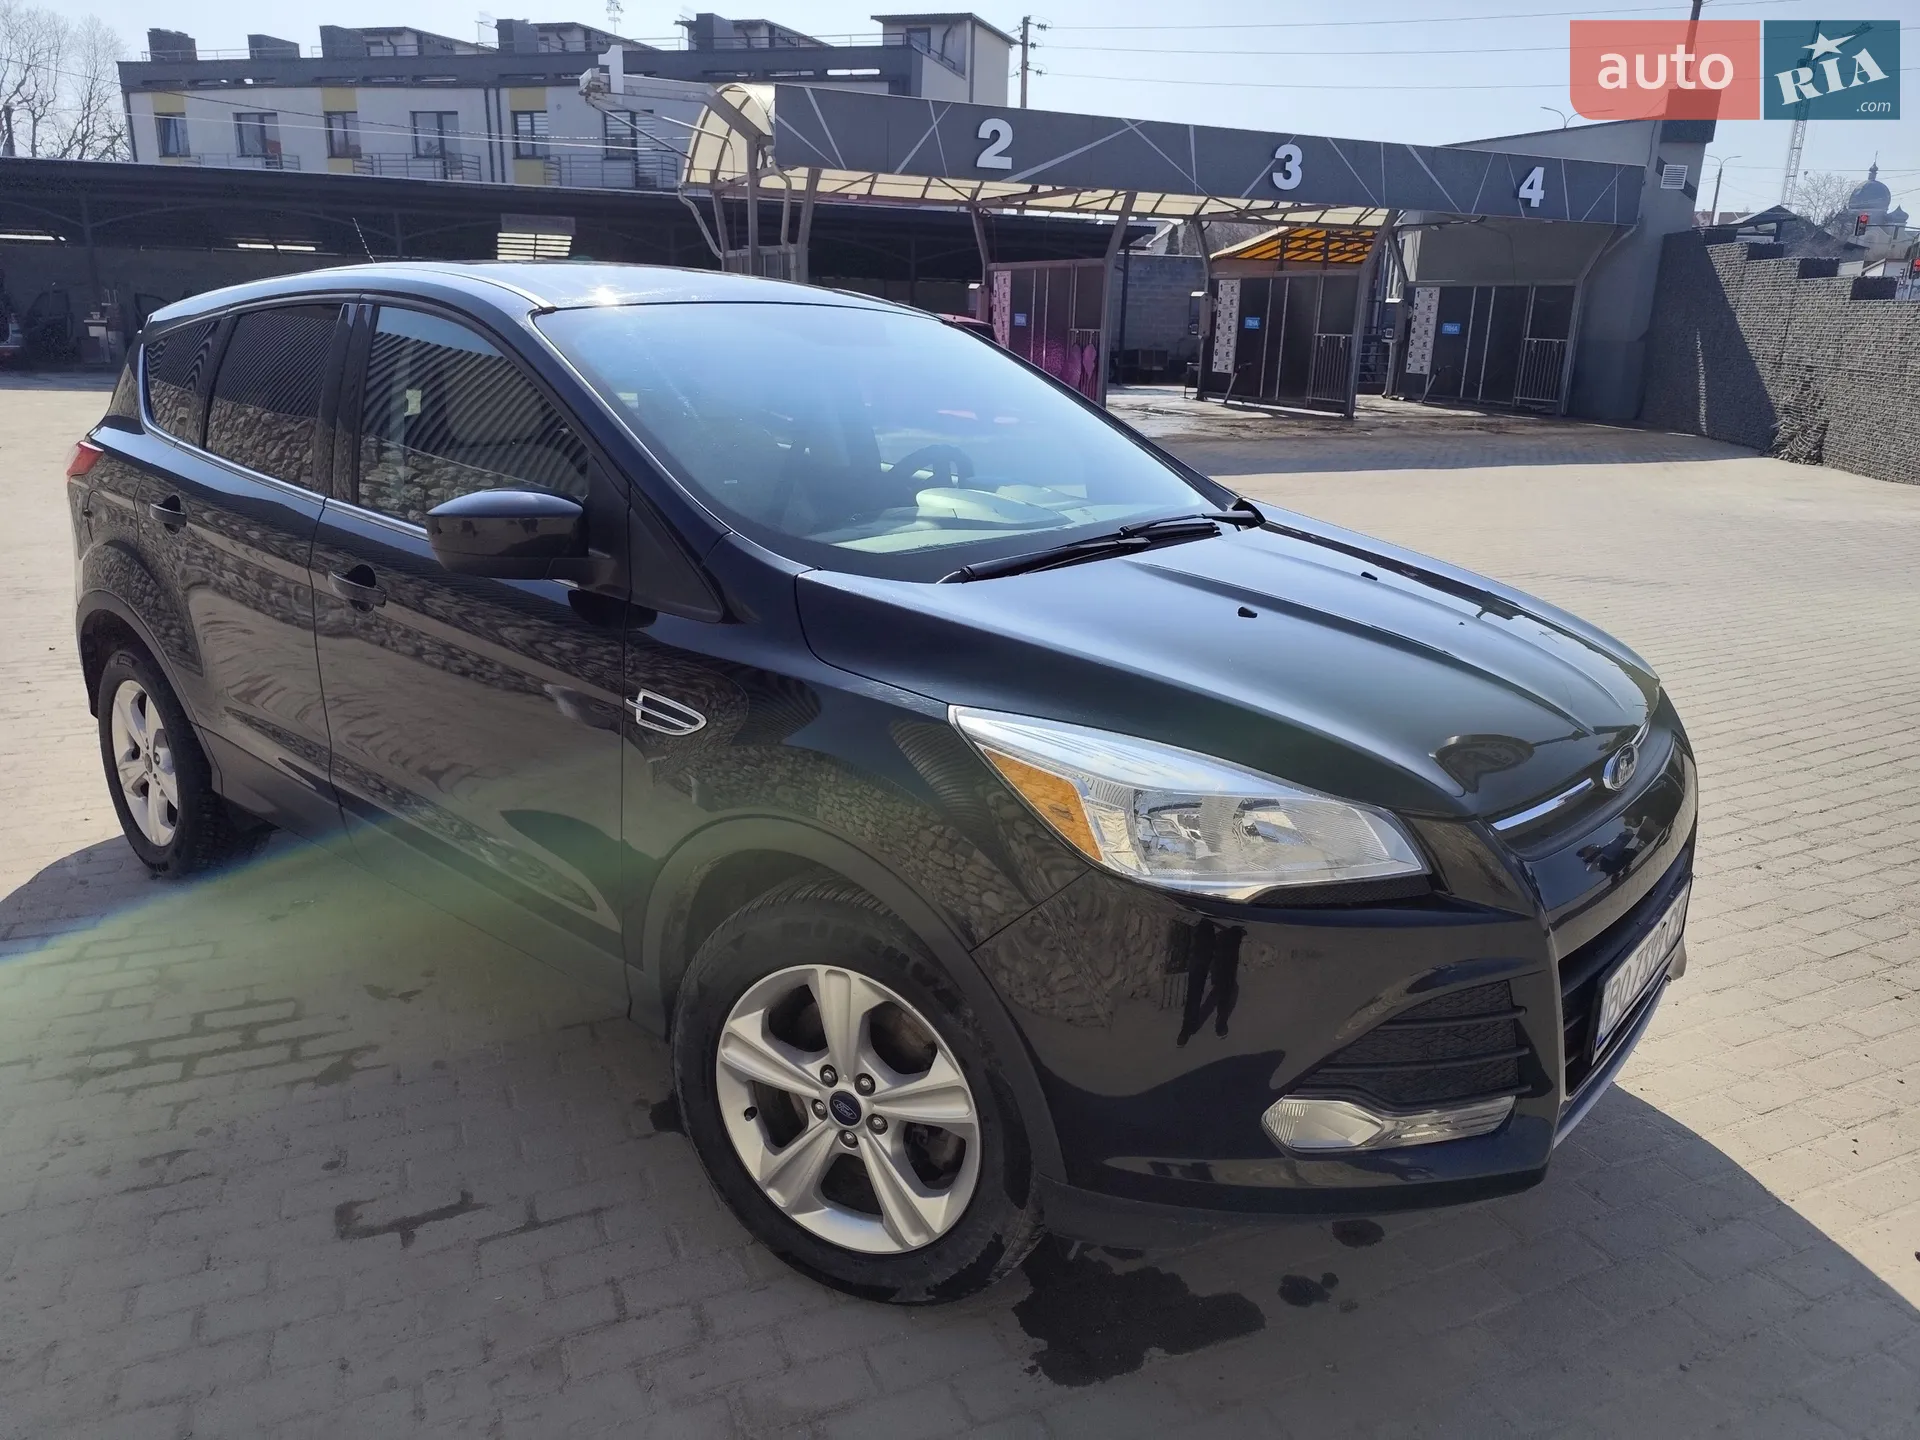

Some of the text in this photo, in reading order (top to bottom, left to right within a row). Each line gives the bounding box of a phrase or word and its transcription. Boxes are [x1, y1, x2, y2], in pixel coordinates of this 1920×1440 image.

[598, 45, 624, 94] 1
[976, 118, 1013, 169] 2
[1272, 144, 1302, 190] 3
[1519, 166, 1545, 207] 4
[836, 1101, 853, 1118] Ford
